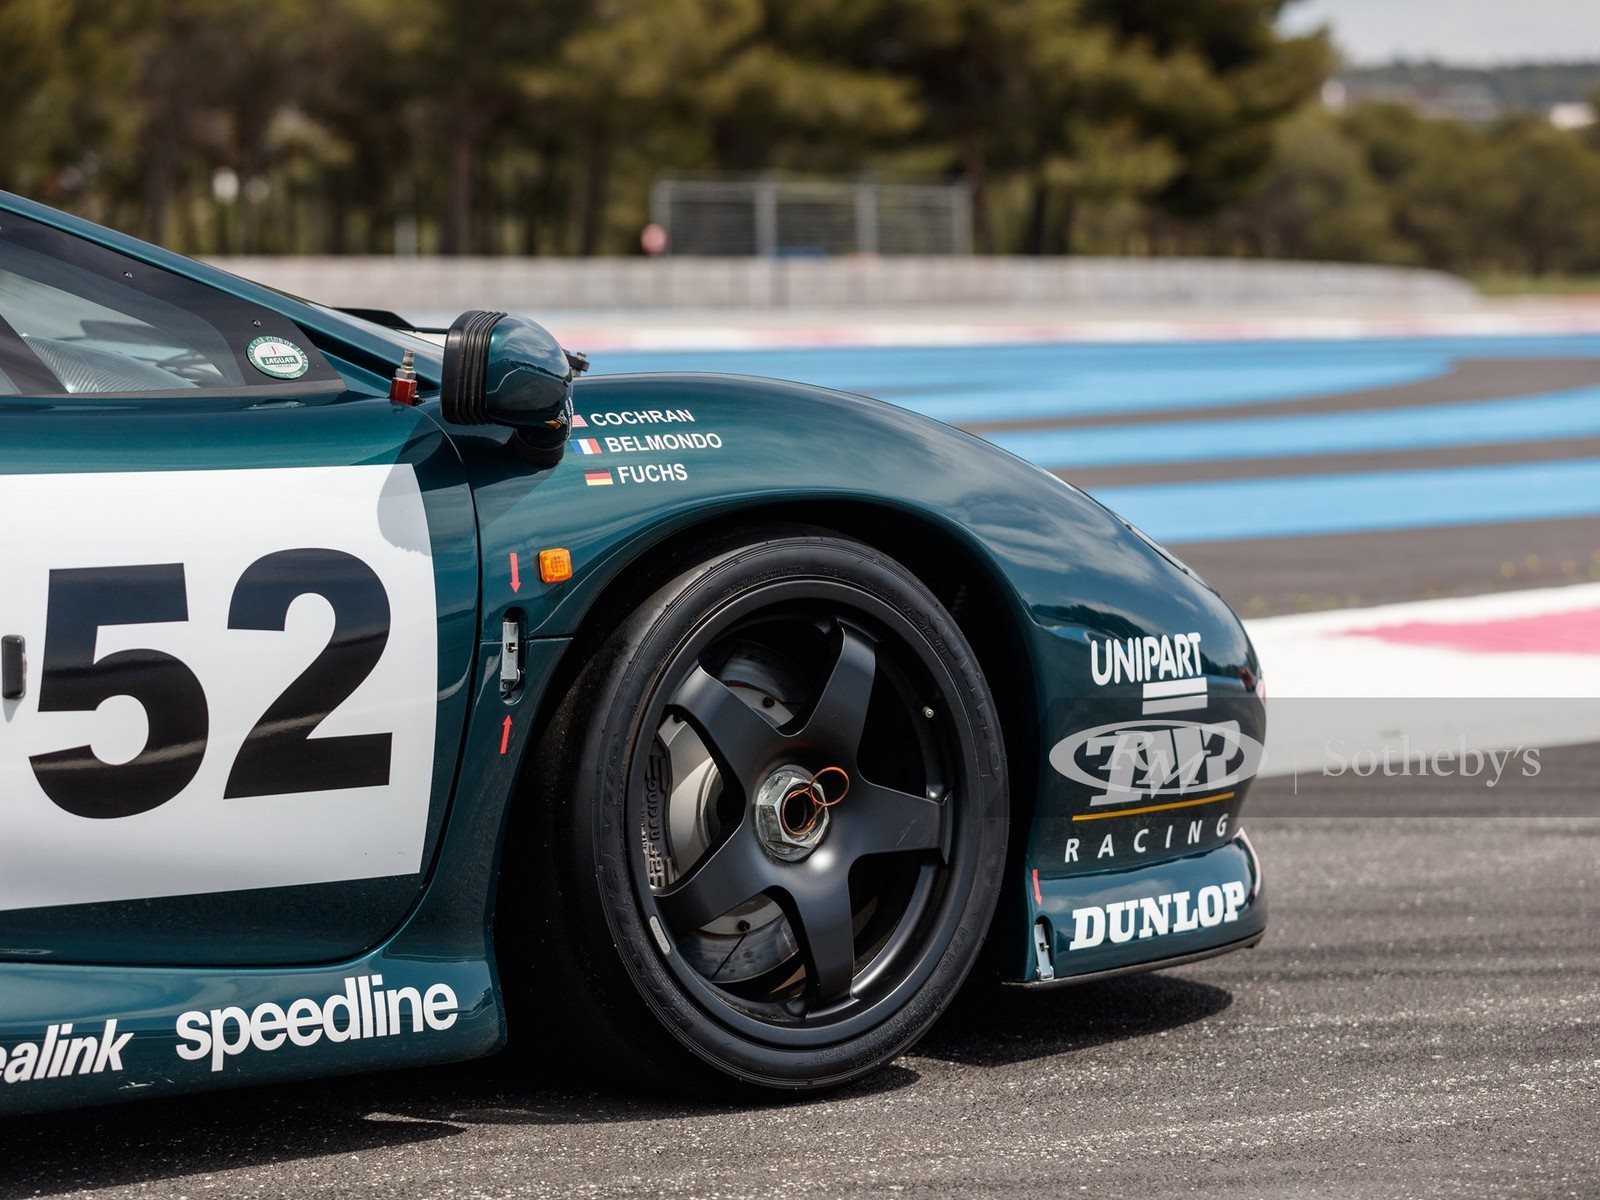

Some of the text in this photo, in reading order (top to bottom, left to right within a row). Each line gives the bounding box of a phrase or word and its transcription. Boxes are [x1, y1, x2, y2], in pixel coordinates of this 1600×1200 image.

[265, 357, 296, 365] JAGUAR
[590, 409, 695, 426] COCHRAN
[604, 432, 723, 453] BELMONDO
[617, 463, 688, 484] FUCHS
[28, 547, 393, 820] 52
[1090, 632, 1202, 686] UNIPART
[1064, 813, 1230, 863] RACING
[1069, 880, 1246, 951] DUNLOP
[0, 974, 459, 1084] alink speedline
